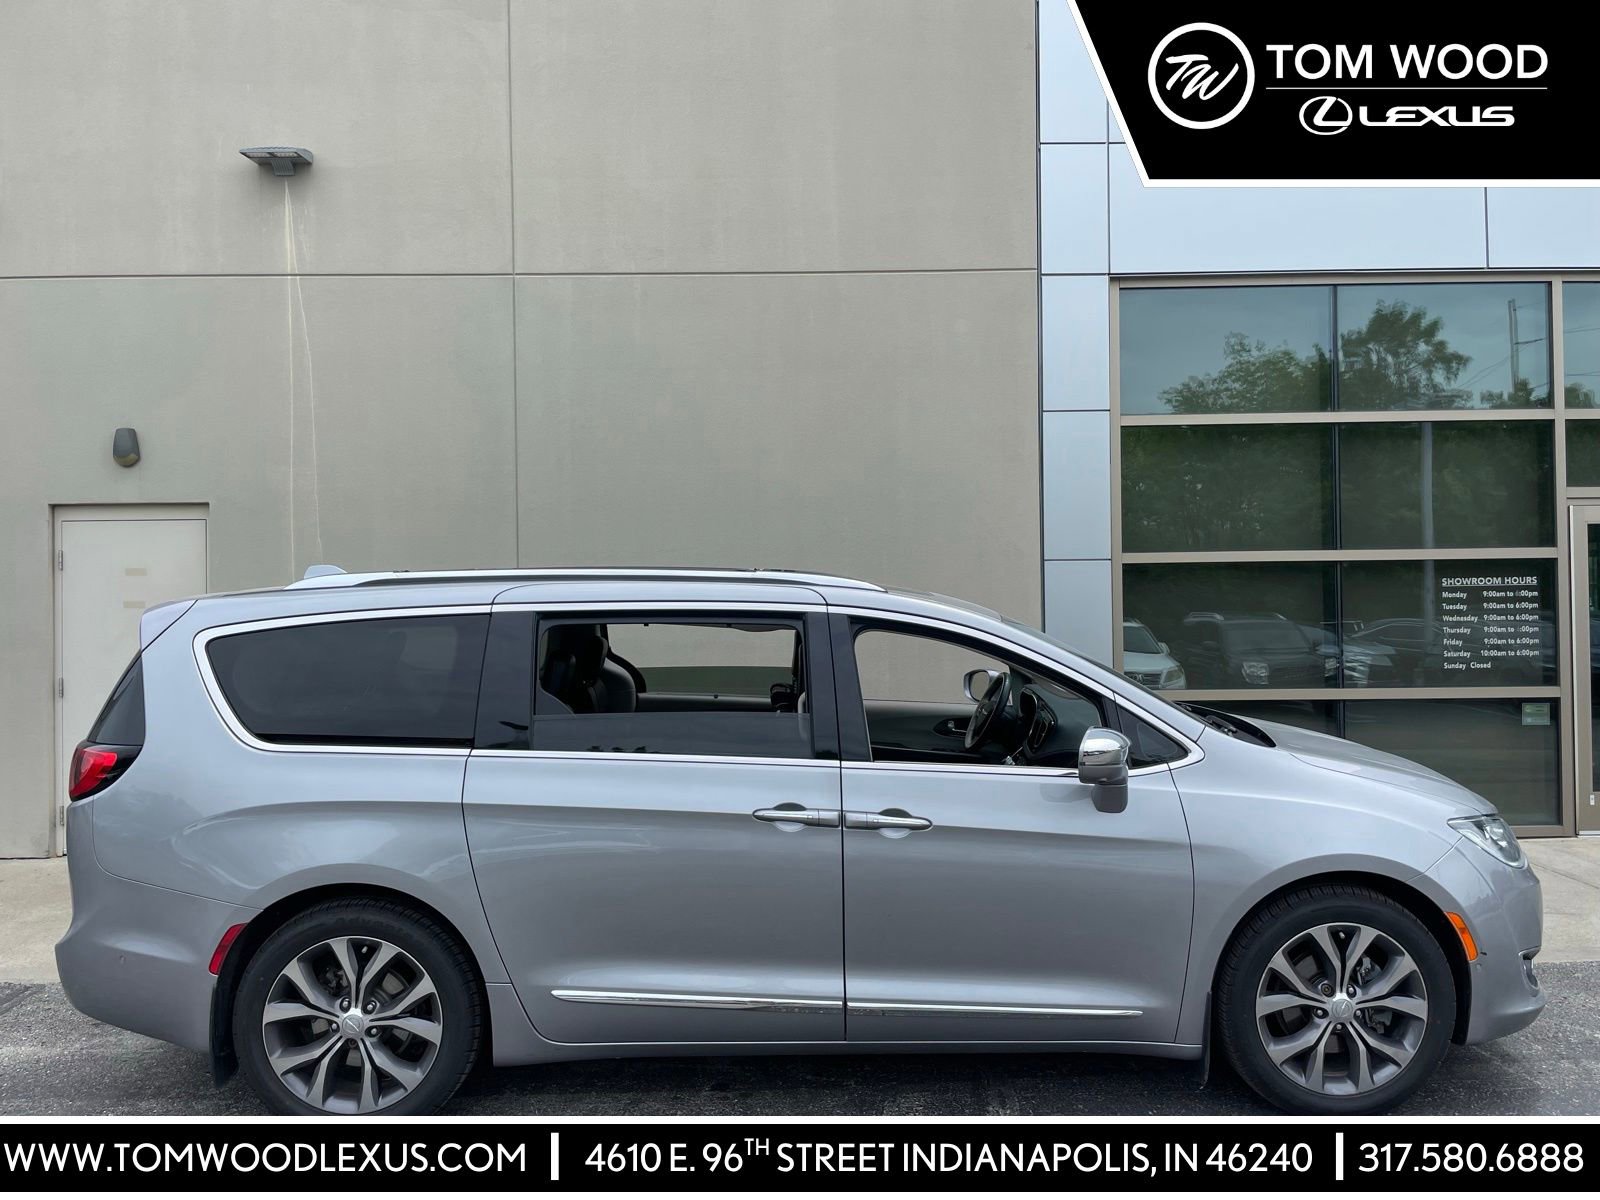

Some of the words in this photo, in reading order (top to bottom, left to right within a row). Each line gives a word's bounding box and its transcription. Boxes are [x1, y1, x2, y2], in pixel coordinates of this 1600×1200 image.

[1442, 577, 1501, 586] SHOWROOM
[1505, 576, 1537, 585] HOURS
[1516, 602, 1538, 610] 6:00pm
